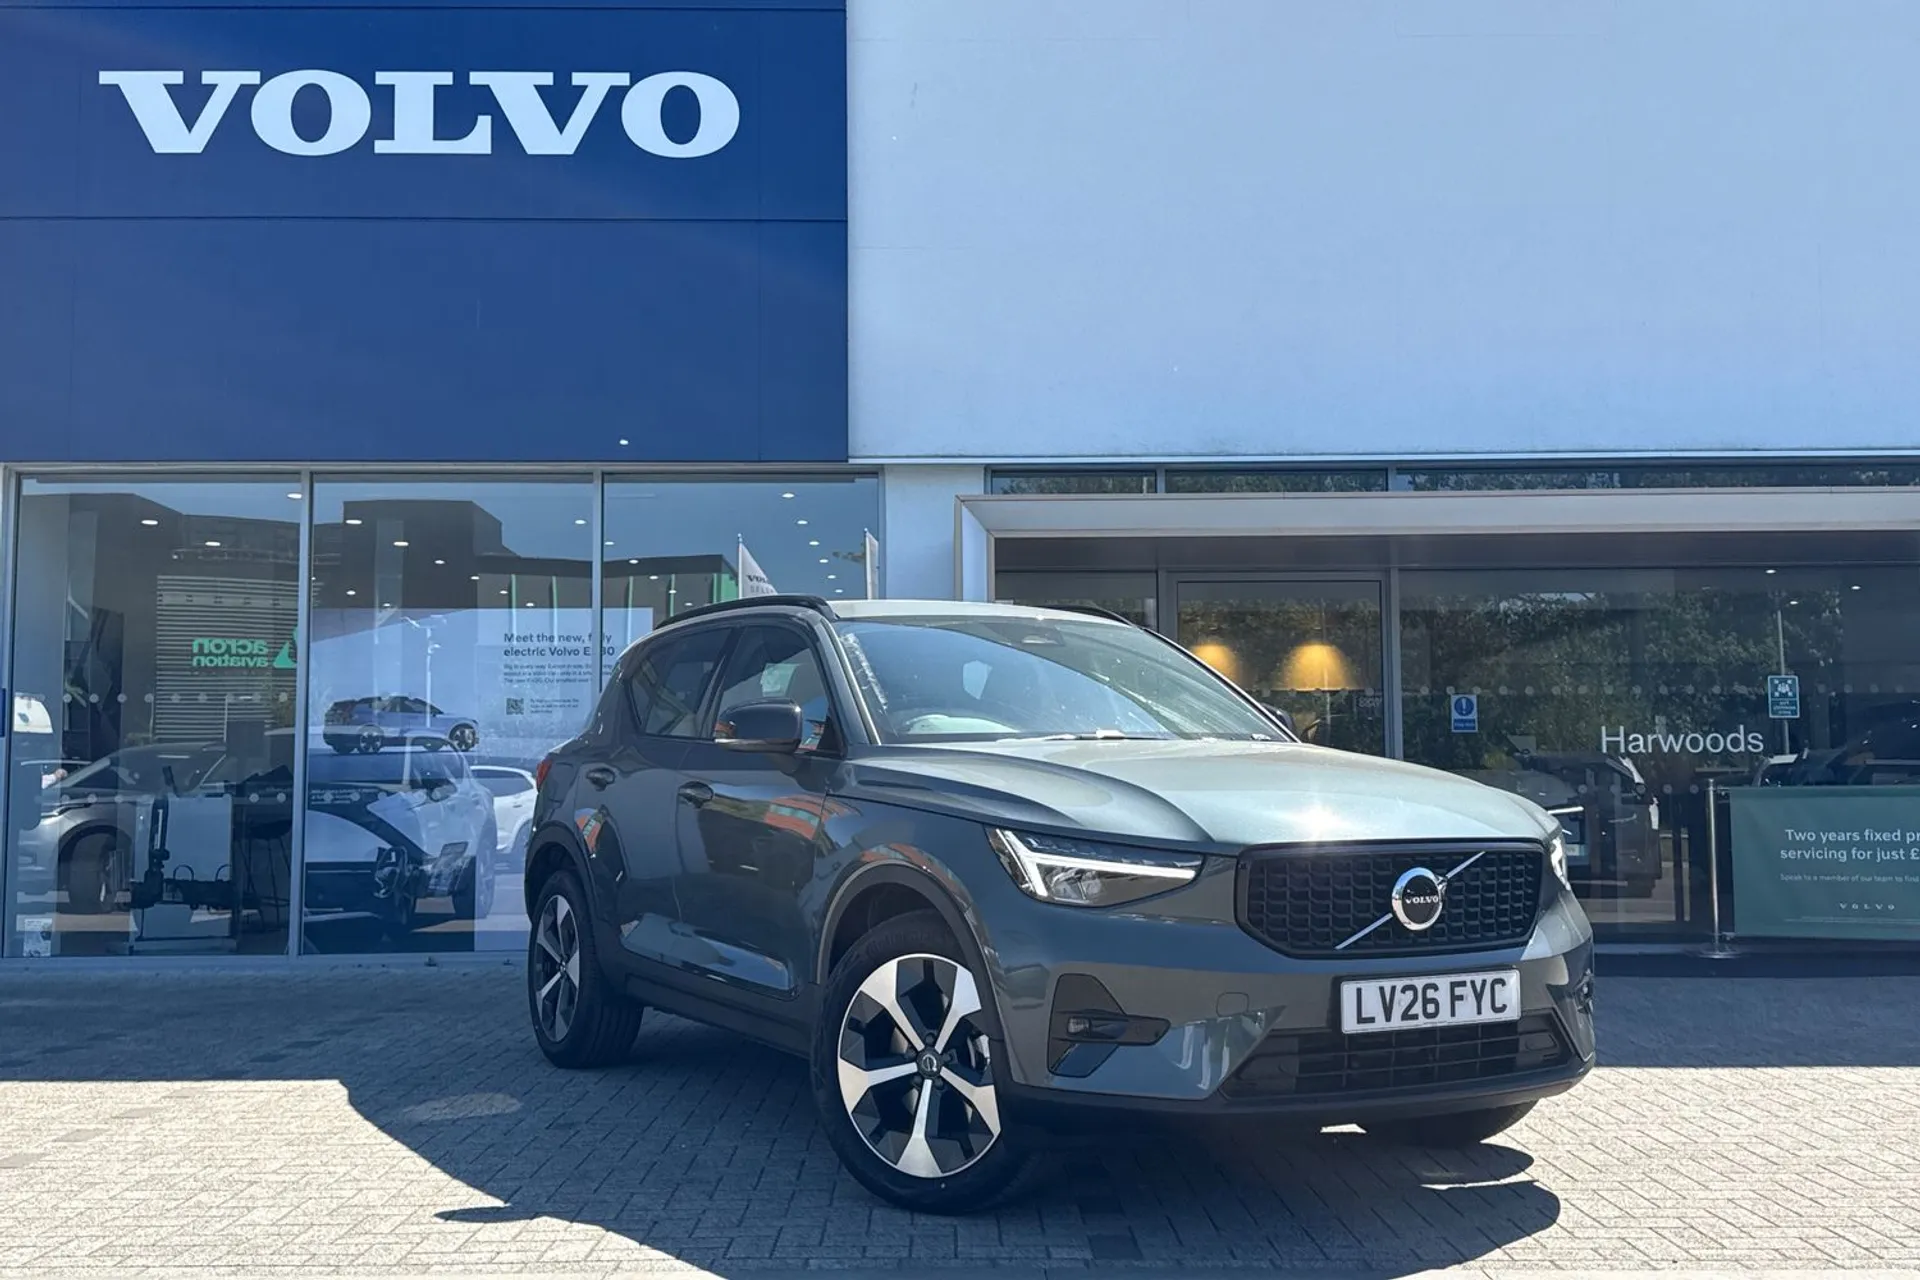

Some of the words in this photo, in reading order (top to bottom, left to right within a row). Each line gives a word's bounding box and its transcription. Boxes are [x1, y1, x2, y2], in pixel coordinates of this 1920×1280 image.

[98, 69, 741, 158] VOLVO
[504, 633, 534, 643] Meet
[536, 633, 556, 643] the
[558, 635, 585, 643] new,
[588, 632, 612, 644] fly
[503, 647, 546, 657] electric
[549, 647, 580, 657] Volvo
[583, 646, 616, 657] E30
[1601, 724, 1764, 754] Harwoods
[1785, 829, 1816, 841] Two
[1820, 831, 1860, 844] years
[1864, 828, 1901, 841] fixed
[1780, 847, 1847, 862] servicing
[1851, 847, 1873, 860] for
[1876, 848, 1905, 862] just
[1851, 874, 1859, 882] of
[1405, 895, 1439, 904] VOLVO
[1839, 902, 1895, 910] VOLVO
[1356, 982, 1440, 1025] LV26
[1449, 977, 1508, 1018] FYC
